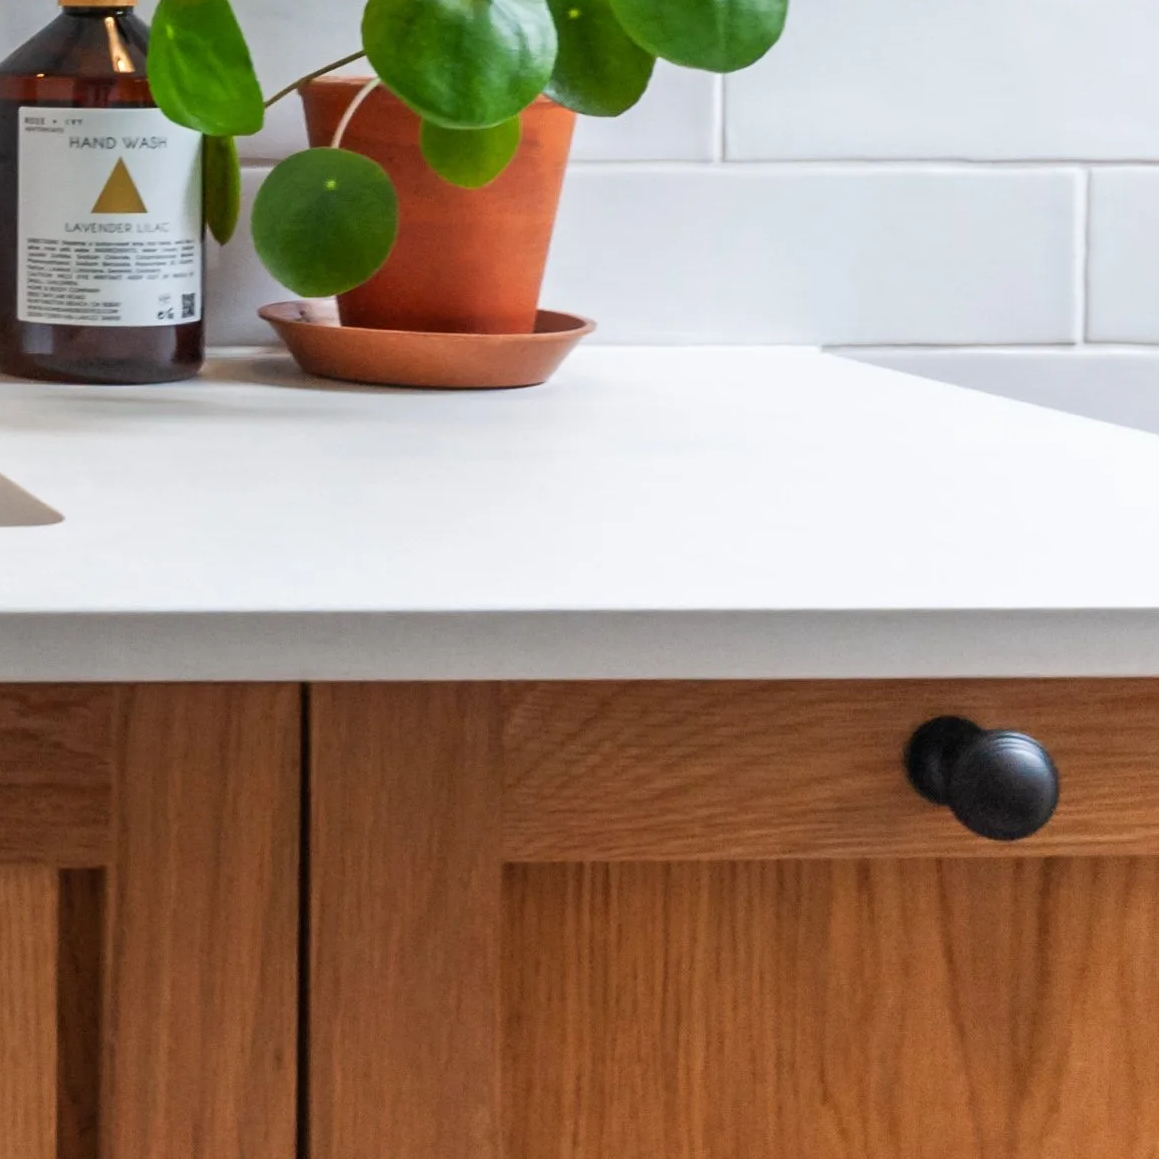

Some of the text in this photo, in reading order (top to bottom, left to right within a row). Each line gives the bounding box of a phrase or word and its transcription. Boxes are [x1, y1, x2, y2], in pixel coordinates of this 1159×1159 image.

[69, 136, 168, 150] HAND WASH
[64, 222, 170, 233] LAVENDER LILAC
